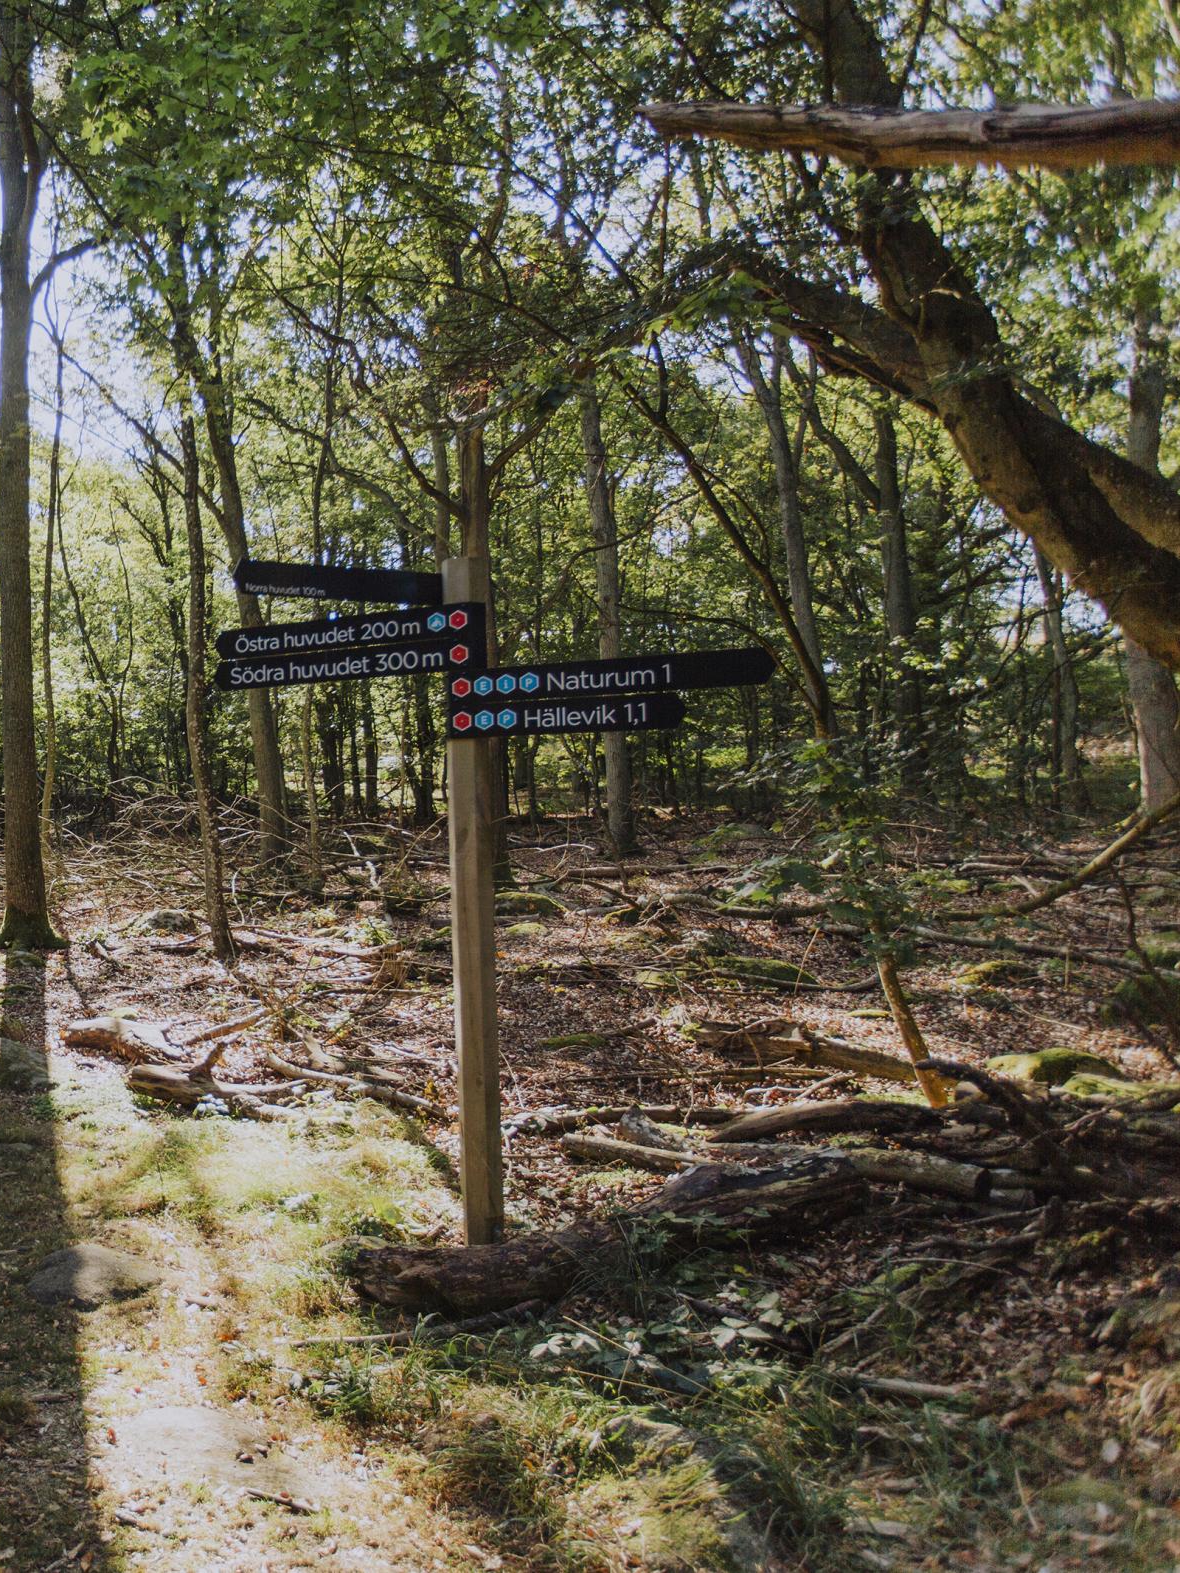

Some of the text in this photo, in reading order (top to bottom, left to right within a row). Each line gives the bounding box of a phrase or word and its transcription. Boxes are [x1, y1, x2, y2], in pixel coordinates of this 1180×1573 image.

[235, 634, 280, 653] Östra
[284, 627, 355, 648] huvudet
[231, 664, 284, 684] Södra
[289, 656, 370, 680] huvudet
[547, 668, 655, 691] Naturum
[662, 664, 671, 683] 1
[524, 704, 616, 728] Hällevik
[623, 702, 647, 726] 1,1
